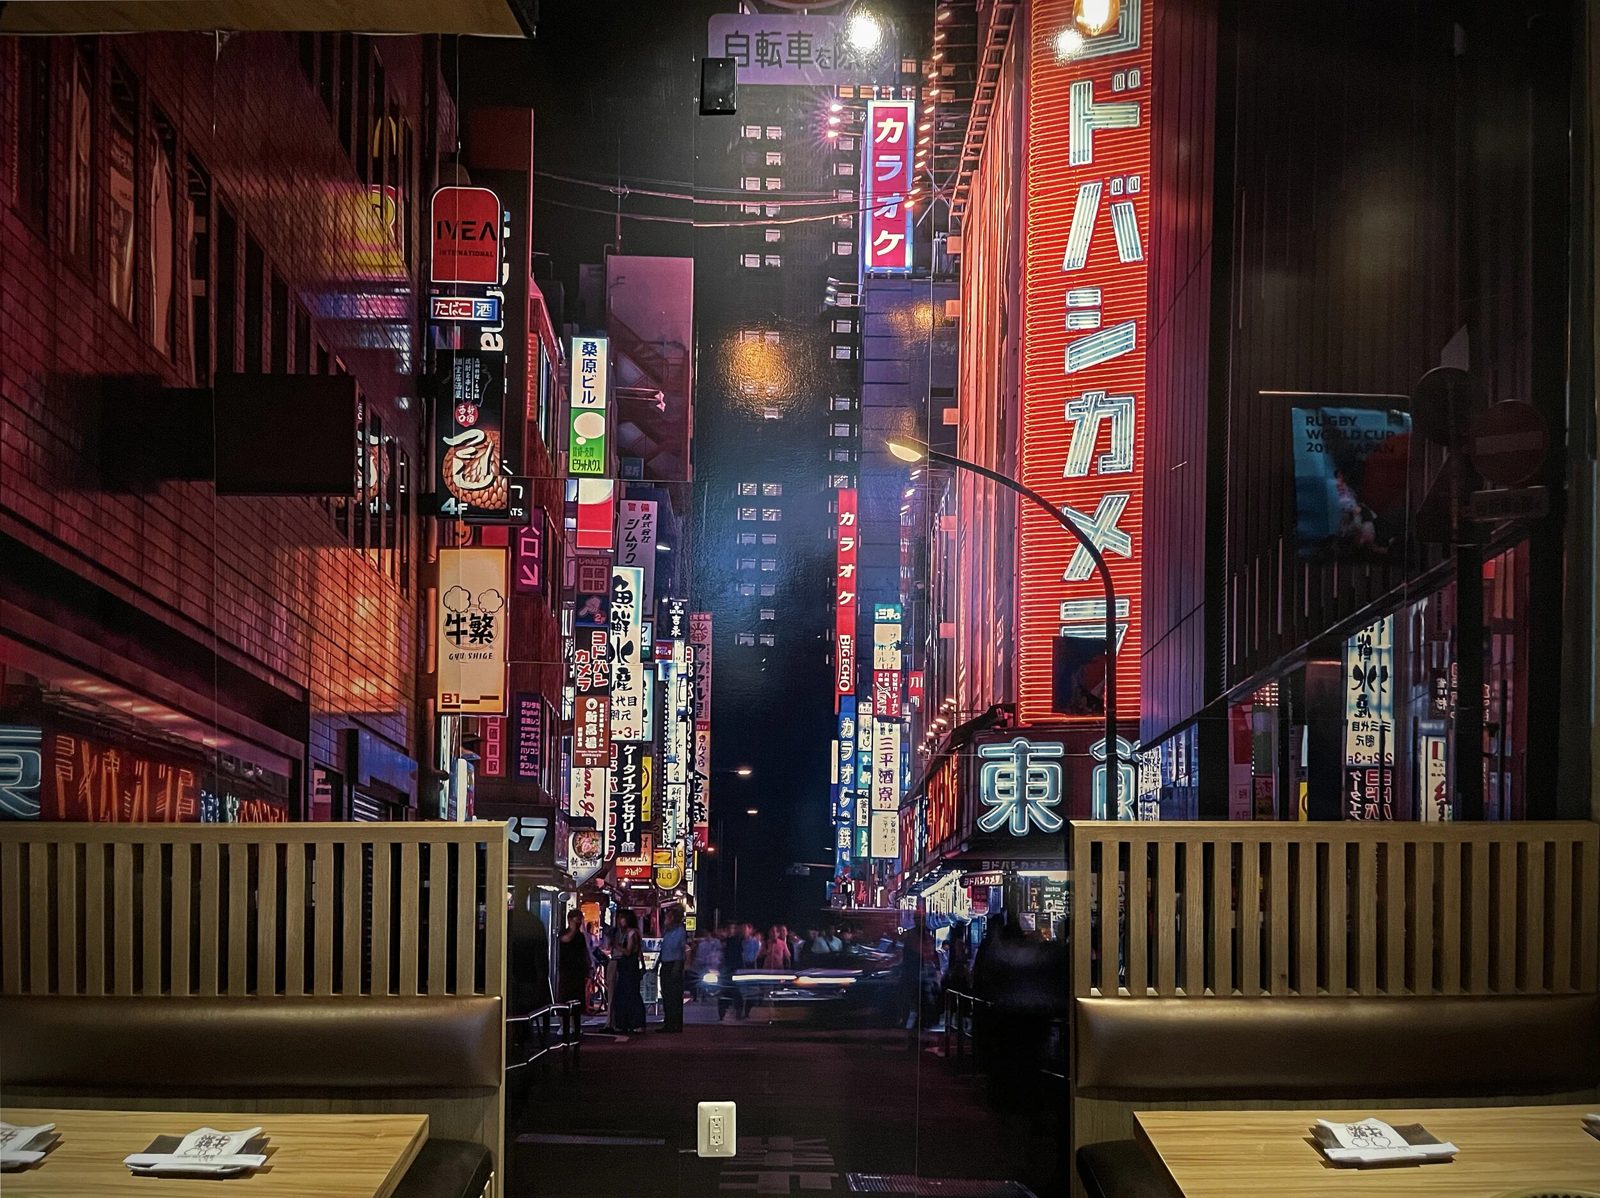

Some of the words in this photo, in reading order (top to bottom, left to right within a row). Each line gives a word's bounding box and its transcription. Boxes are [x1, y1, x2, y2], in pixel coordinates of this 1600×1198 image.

[874, 118, 904, 256] カラオケ
[435, 301, 472, 316] たばこ
[476, 302, 493, 317] 酒
[582, 341, 598, 404] 桑原ビル
[1305, 416, 1357, 426] RUGBY
[440, 497, 468, 515] 4F
[641, 514, 652, 543] 株式会社
[838, 511, 855, 606] カラオケ
[445, 613, 494, 645] 牛繁
[468, 652, 493, 660] SHIGE
[591, 631, 609, 687] ヨドバシ
[839, 634, 851, 657] BIG
[575, 650, 592, 692] カメラ
[838, 657, 851, 692] ECHO
[441, 693, 460, 703] B1
[586, 757, 598, 765] B1
[620, 744, 637, 853] ケータイアクセサリー館
